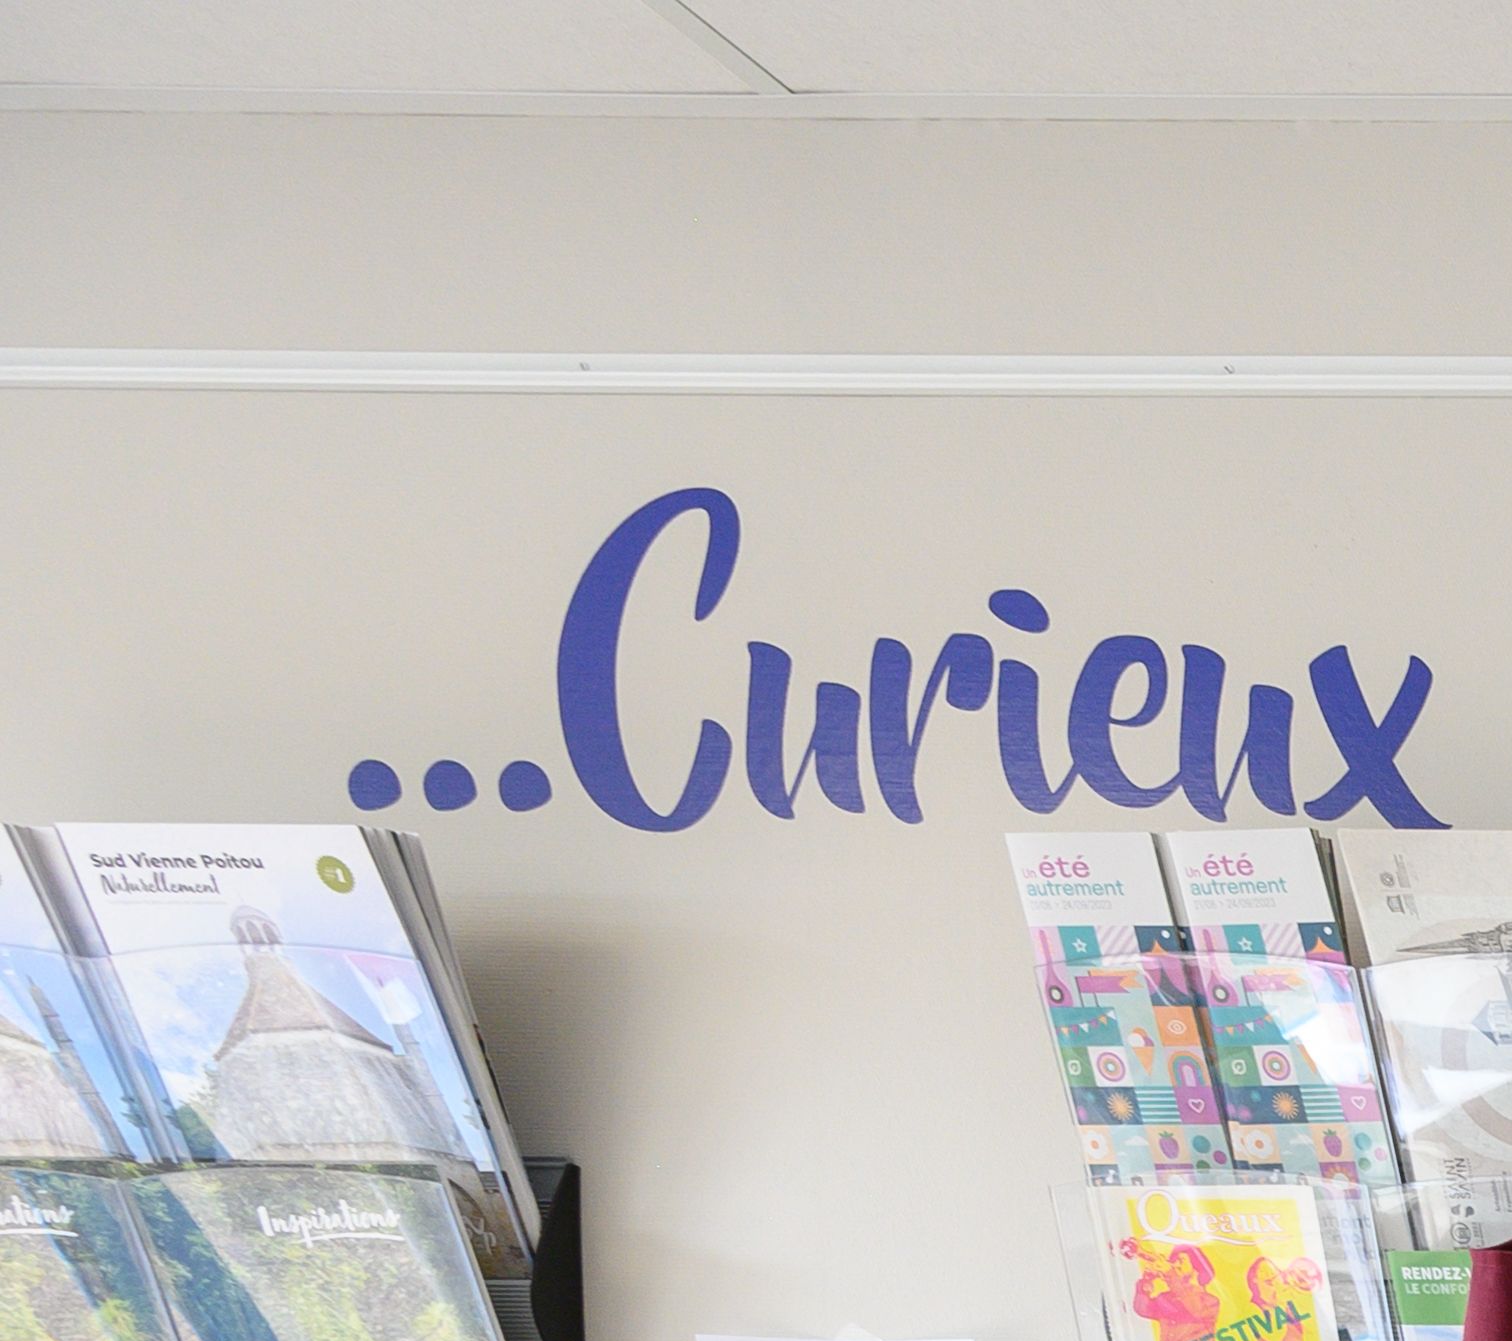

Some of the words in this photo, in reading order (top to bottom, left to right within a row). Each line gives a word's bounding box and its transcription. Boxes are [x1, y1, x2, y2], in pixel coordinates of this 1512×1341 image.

[89, 853, 125, 869] Sud
[131, 852, 197, 869] Vienne
[202, 852, 265, 870] Poitou
[1039, 854, 1089, 878] été
[1204, 853, 1254, 877] été
[1027, 880, 1124, 896] autrement
[1191, 878, 1288, 896] autrement
[258, 1199, 401, 1248] Inspirations
[1136, 1189, 1281, 1246] Queaux
